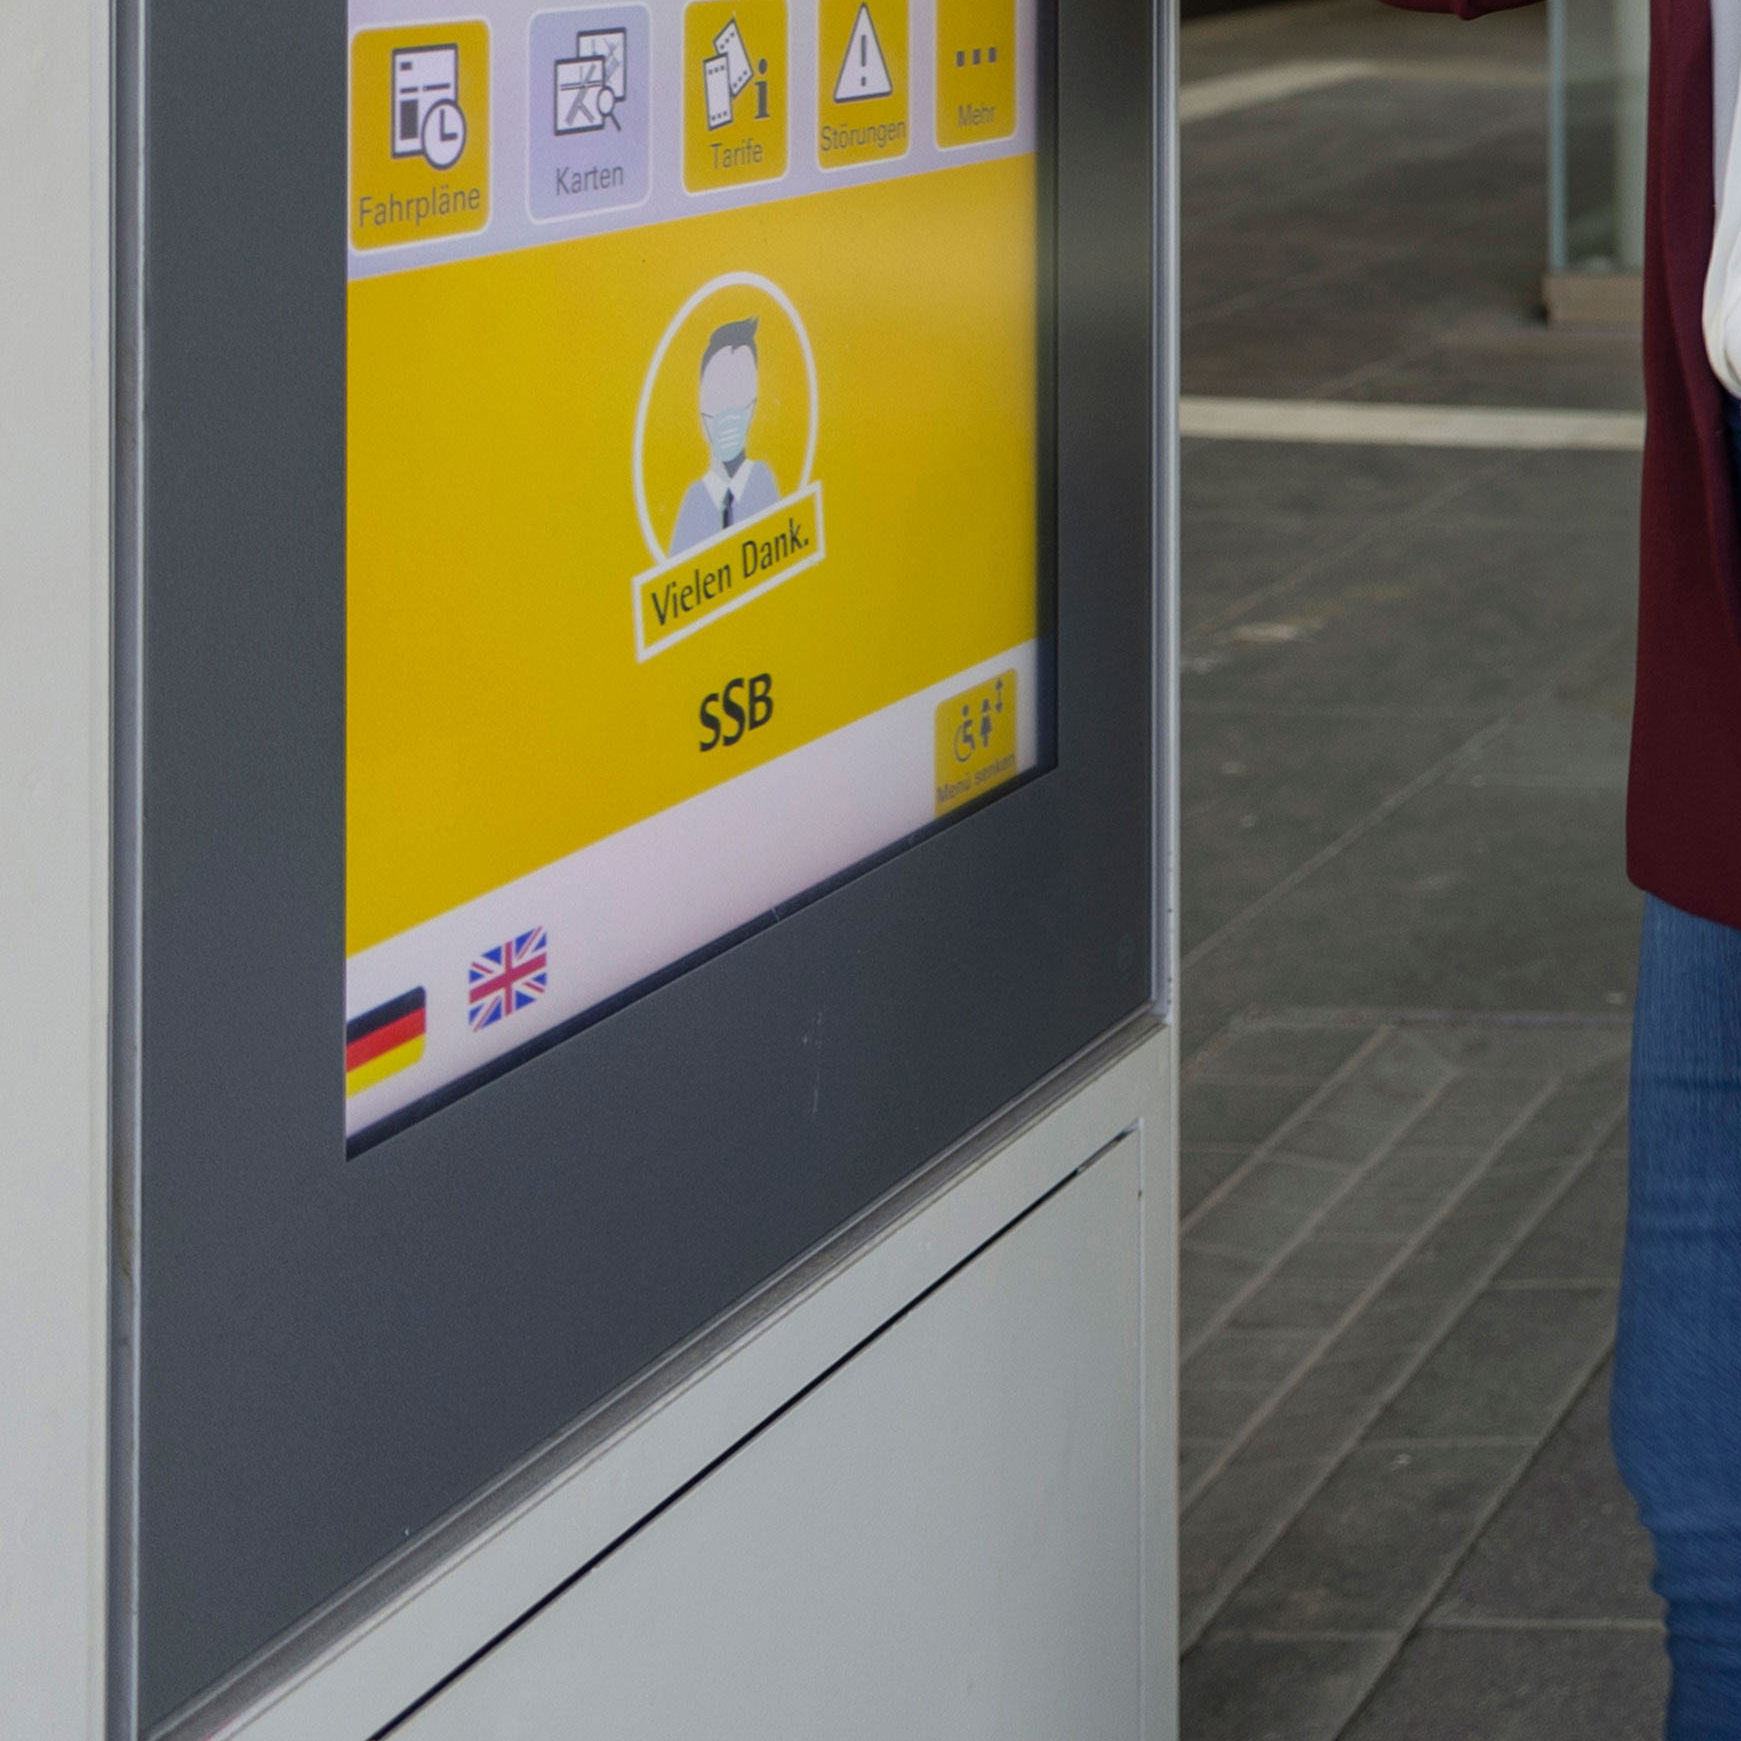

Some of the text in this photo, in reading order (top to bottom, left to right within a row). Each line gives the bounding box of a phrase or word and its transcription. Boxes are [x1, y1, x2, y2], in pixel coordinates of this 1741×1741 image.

[957, 103, 996, 128] Mehr
[821, 120, 906, 152] Störungen
[710, 138, 763, 169] Tarife
[556, 165, 624, 196] Karten
[360, 185, 481, 228] Fahrpläne
[651, 517, 810, 626] Vielen Dank.
[699, 673, 774, 752] SSB
